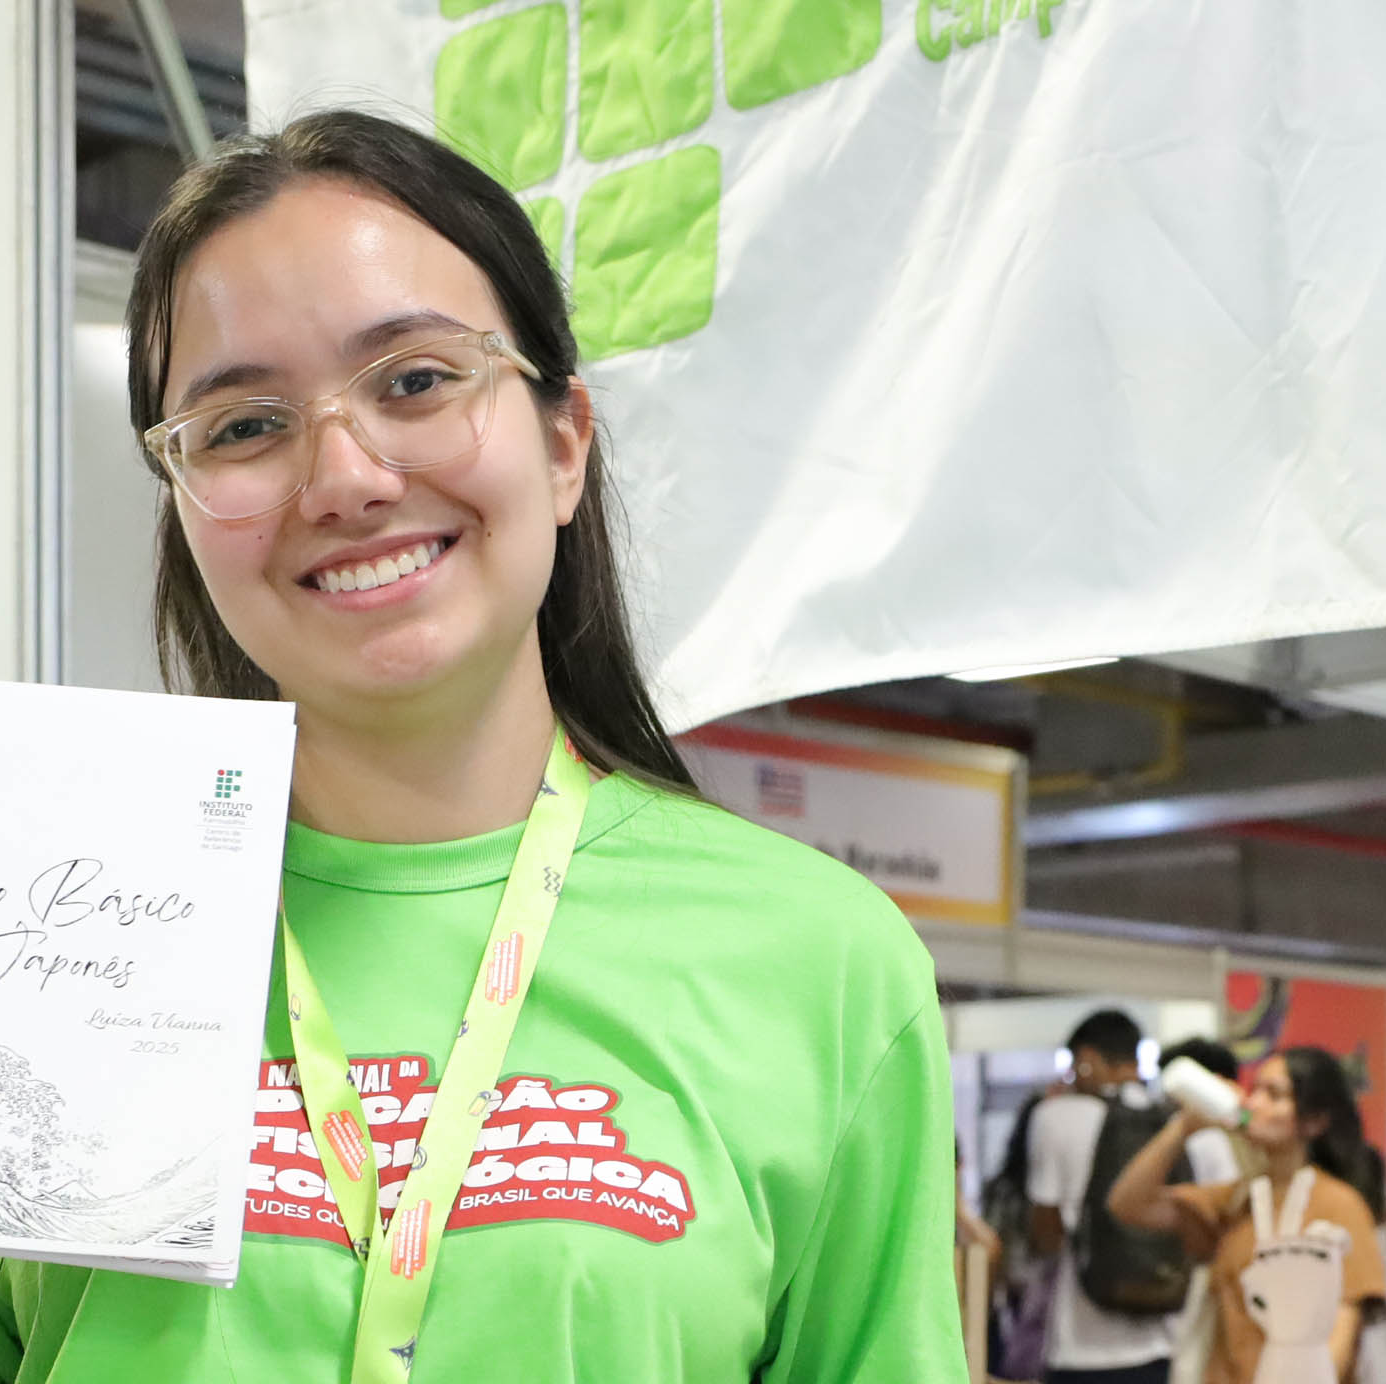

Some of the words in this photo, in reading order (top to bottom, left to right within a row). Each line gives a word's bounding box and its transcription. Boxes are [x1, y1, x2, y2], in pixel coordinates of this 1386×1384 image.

[199, 800, 253, 811] INSTITUTO
[203, 808, 247, 818] FEDERAL
[28, 857, 196, 927] Básico
[129, 1040, 181, 1055] 2025
[398, 1060, 420, 1078] DA
[459, 1188, 538, 1211] BRASIL
[542, 1187, 593, 1201] QUE
[595, 1192, 680, 1231] AVANÇA
